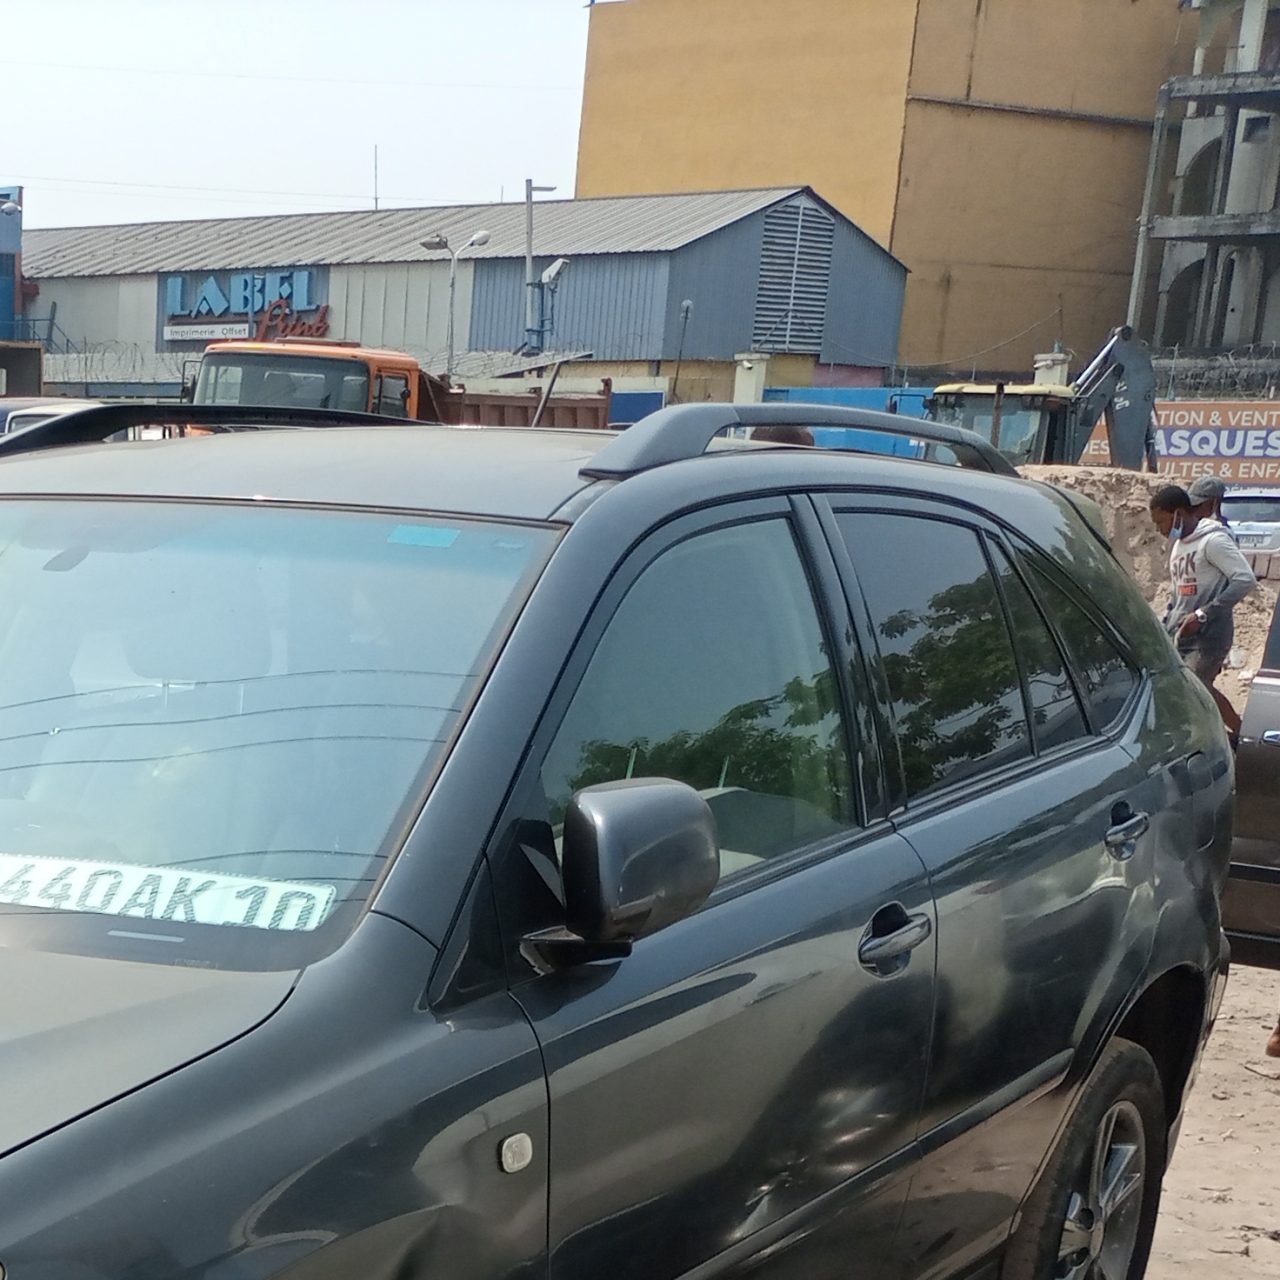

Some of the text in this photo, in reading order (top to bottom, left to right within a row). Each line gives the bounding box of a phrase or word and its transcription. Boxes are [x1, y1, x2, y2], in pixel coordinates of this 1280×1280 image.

[166, 270, 319, 317] LABEL
[170, 327, 247, 338] Imprimerie Offset
[1209, 410, 1222, 426] &
[1219, 463, 1233, 478] &
